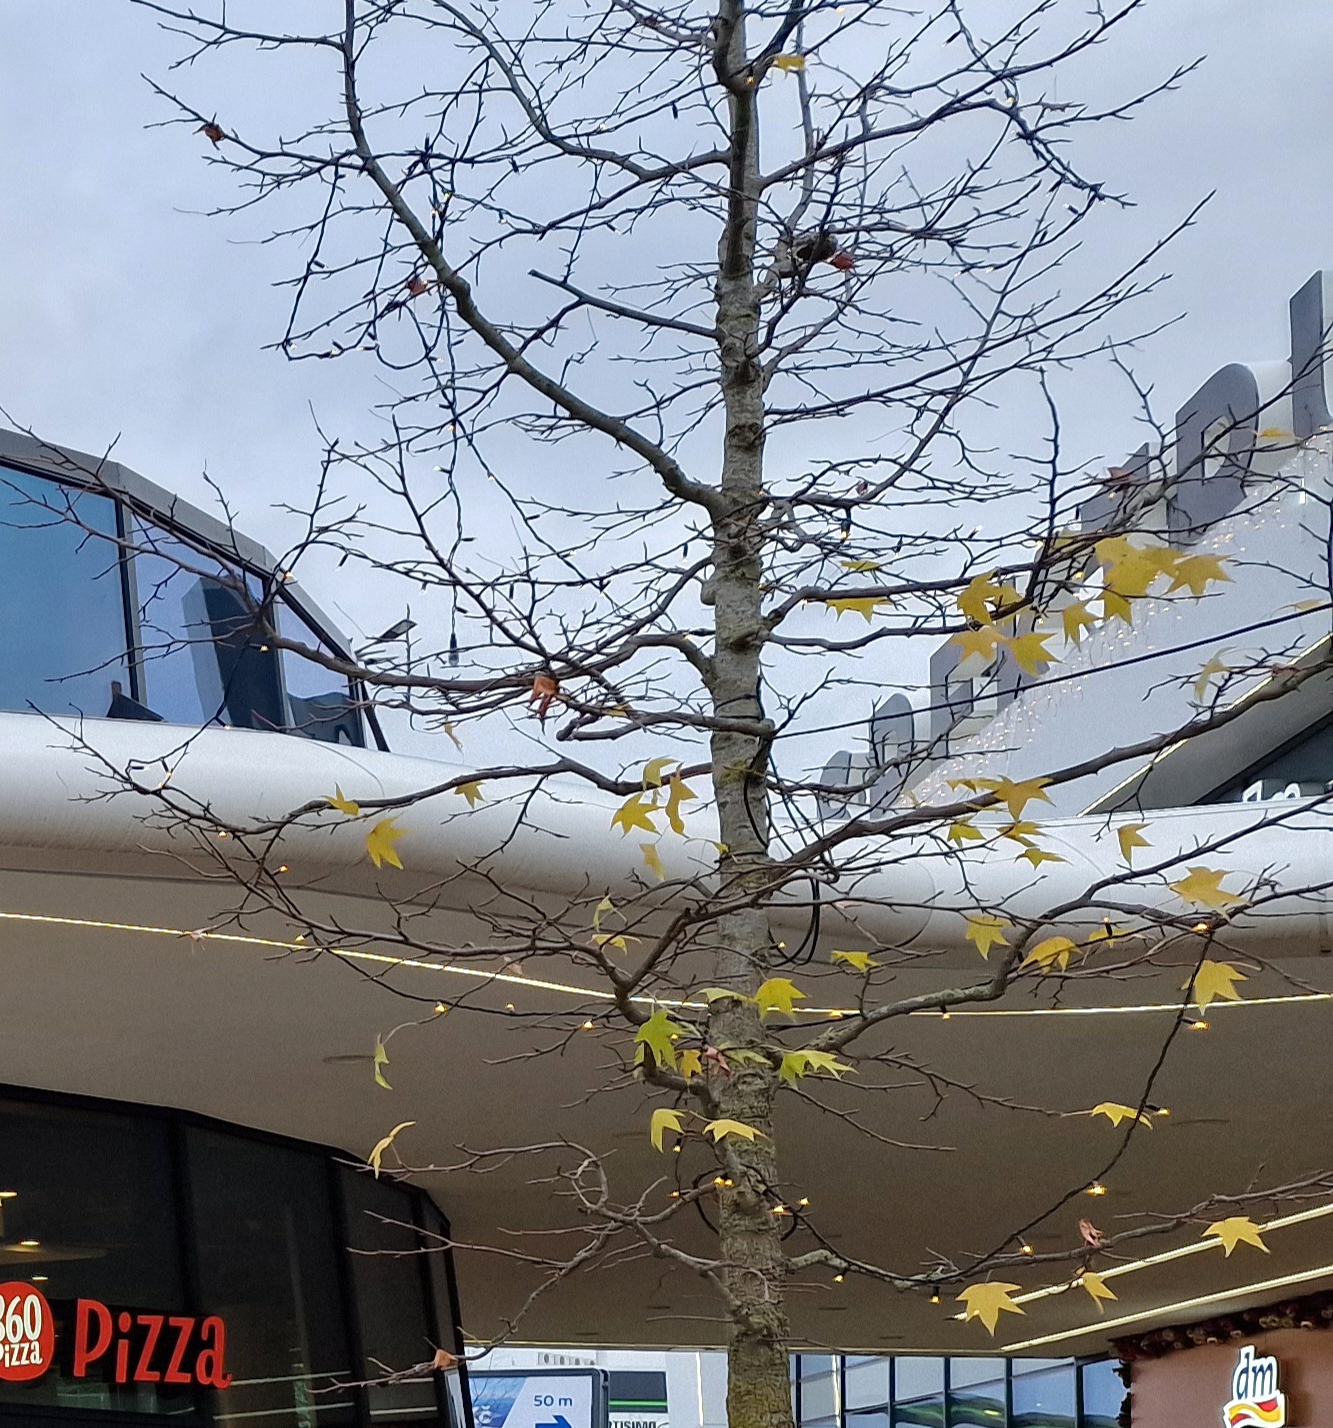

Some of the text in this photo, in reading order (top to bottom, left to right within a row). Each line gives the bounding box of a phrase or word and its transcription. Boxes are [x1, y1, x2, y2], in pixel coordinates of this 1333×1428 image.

[73, 1298, 232, 1390] Pizza
[1236, 1352, 1273, 1400] dm
[533, 1395, 573, 1407] 50 m
